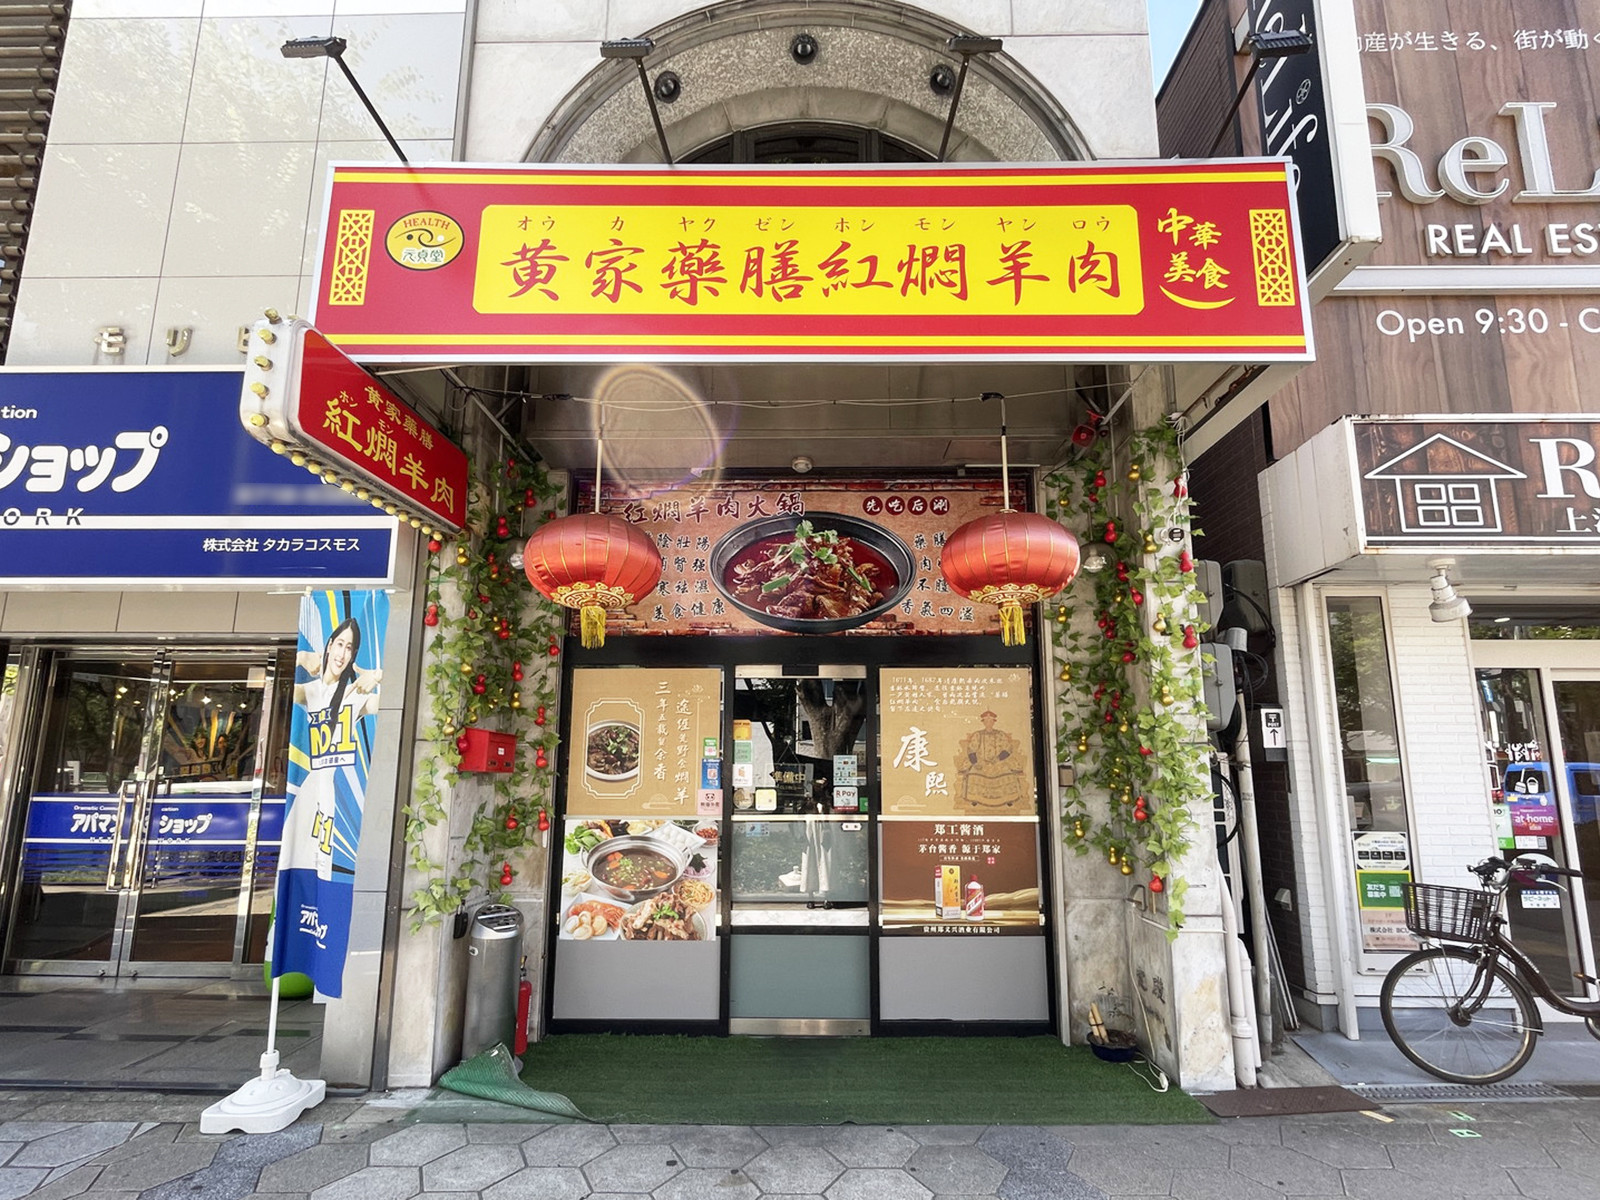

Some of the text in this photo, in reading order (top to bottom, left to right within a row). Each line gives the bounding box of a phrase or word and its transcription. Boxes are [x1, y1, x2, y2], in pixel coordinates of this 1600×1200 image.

[1357, 28, 1600, 52] 産が生きる、街が動く
[403, 217, 451, 230] HEALTH
[517, 214, 1111, 232] オウ カ ヤク ゼン ホン モン ヤン ロウ
[1157, 207, 1222, 250] 中華
[1428, 222, 1600, 254] REAL ES
[1163, 251, 1232, 290] 美食
[1376, 310, 1464, 342] Open
[1474, 308, 1548, 334] 9:30
[339, 390, 394, 435] ホン モン
[203, 538, 360, 552] 株式会社 タカラコスモス
[653, 598, 725, 623] 美食健康
[893, 726, 949, 797] 康熙
[159, 813, 213, 835] ショップ
[1515, 813, 1554, 823] at home
